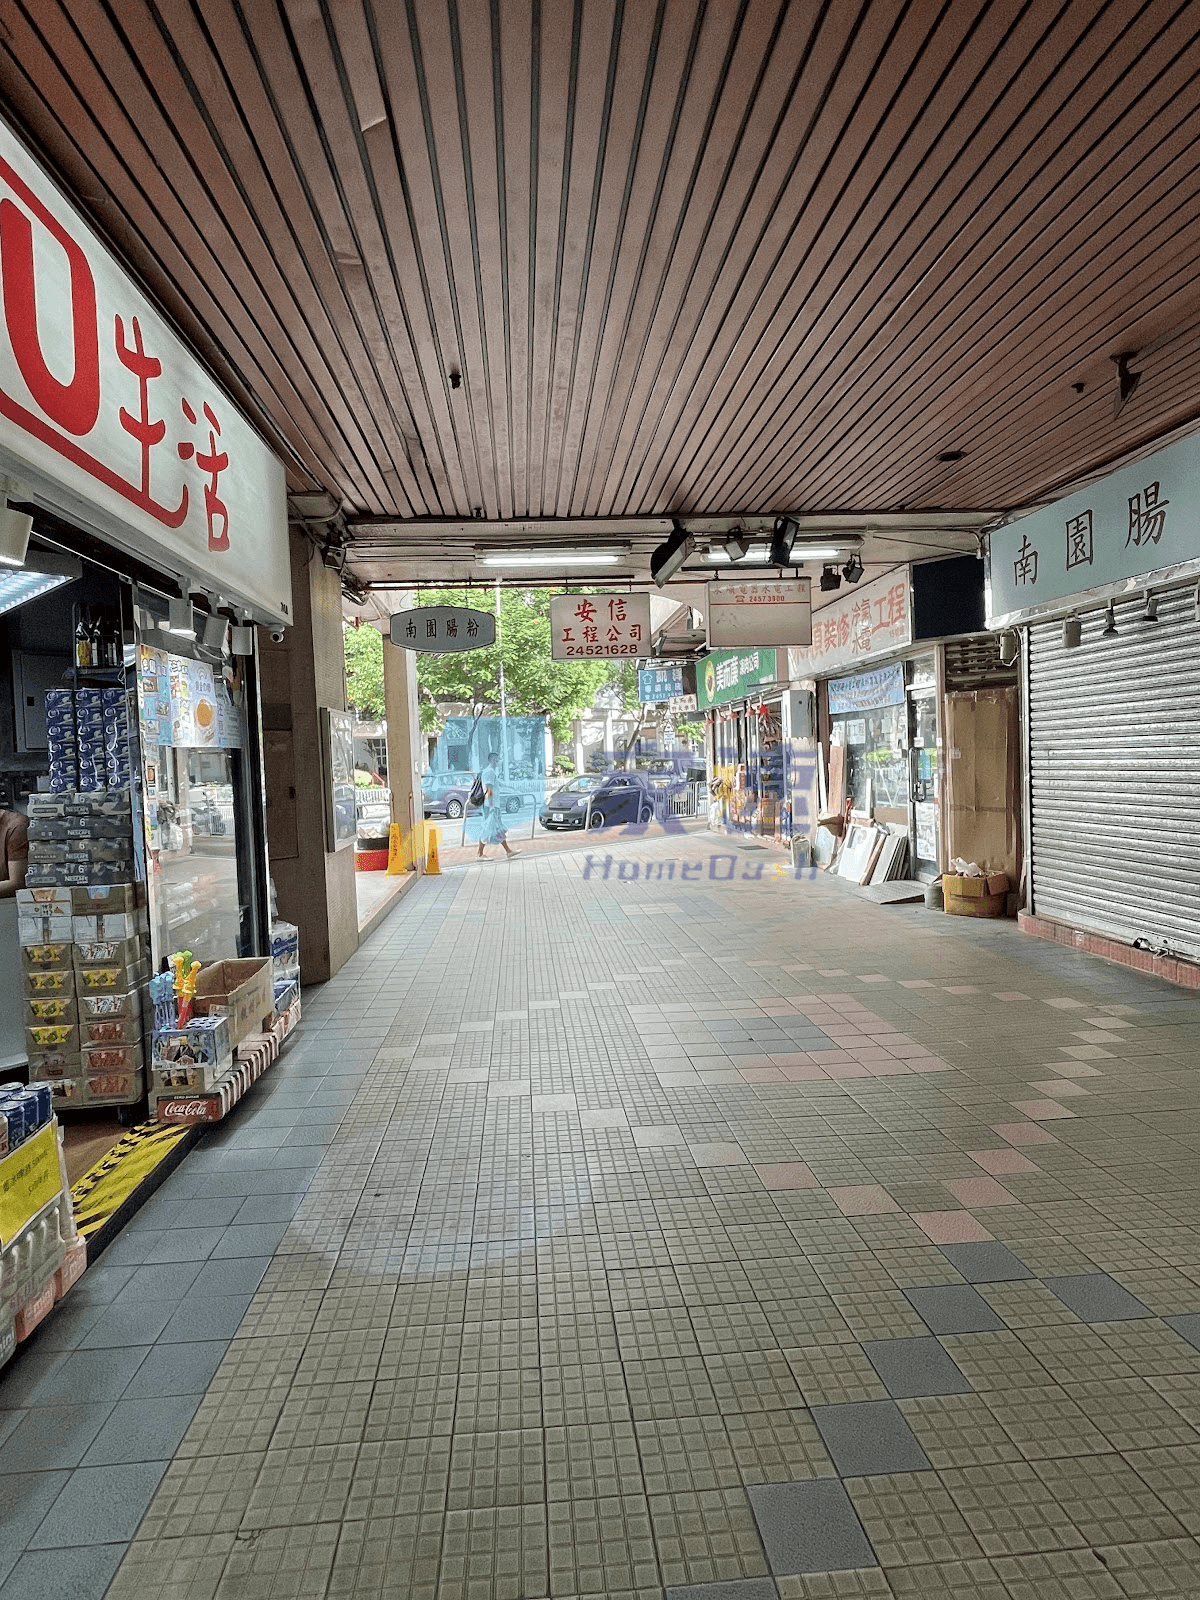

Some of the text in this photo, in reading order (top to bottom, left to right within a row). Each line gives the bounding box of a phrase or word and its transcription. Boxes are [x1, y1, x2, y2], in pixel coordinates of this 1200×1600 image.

[1013, 480, 1170, 586] 南園腸
[573, 598, 628, 622] 安信
[405, 618, 480, 639] 南園腸粉
[562, 624, 643, 643] 工程公司
[566, 644, 638, 656] 24521628
[165, 1101, 209, 1117] Coca-Cola
